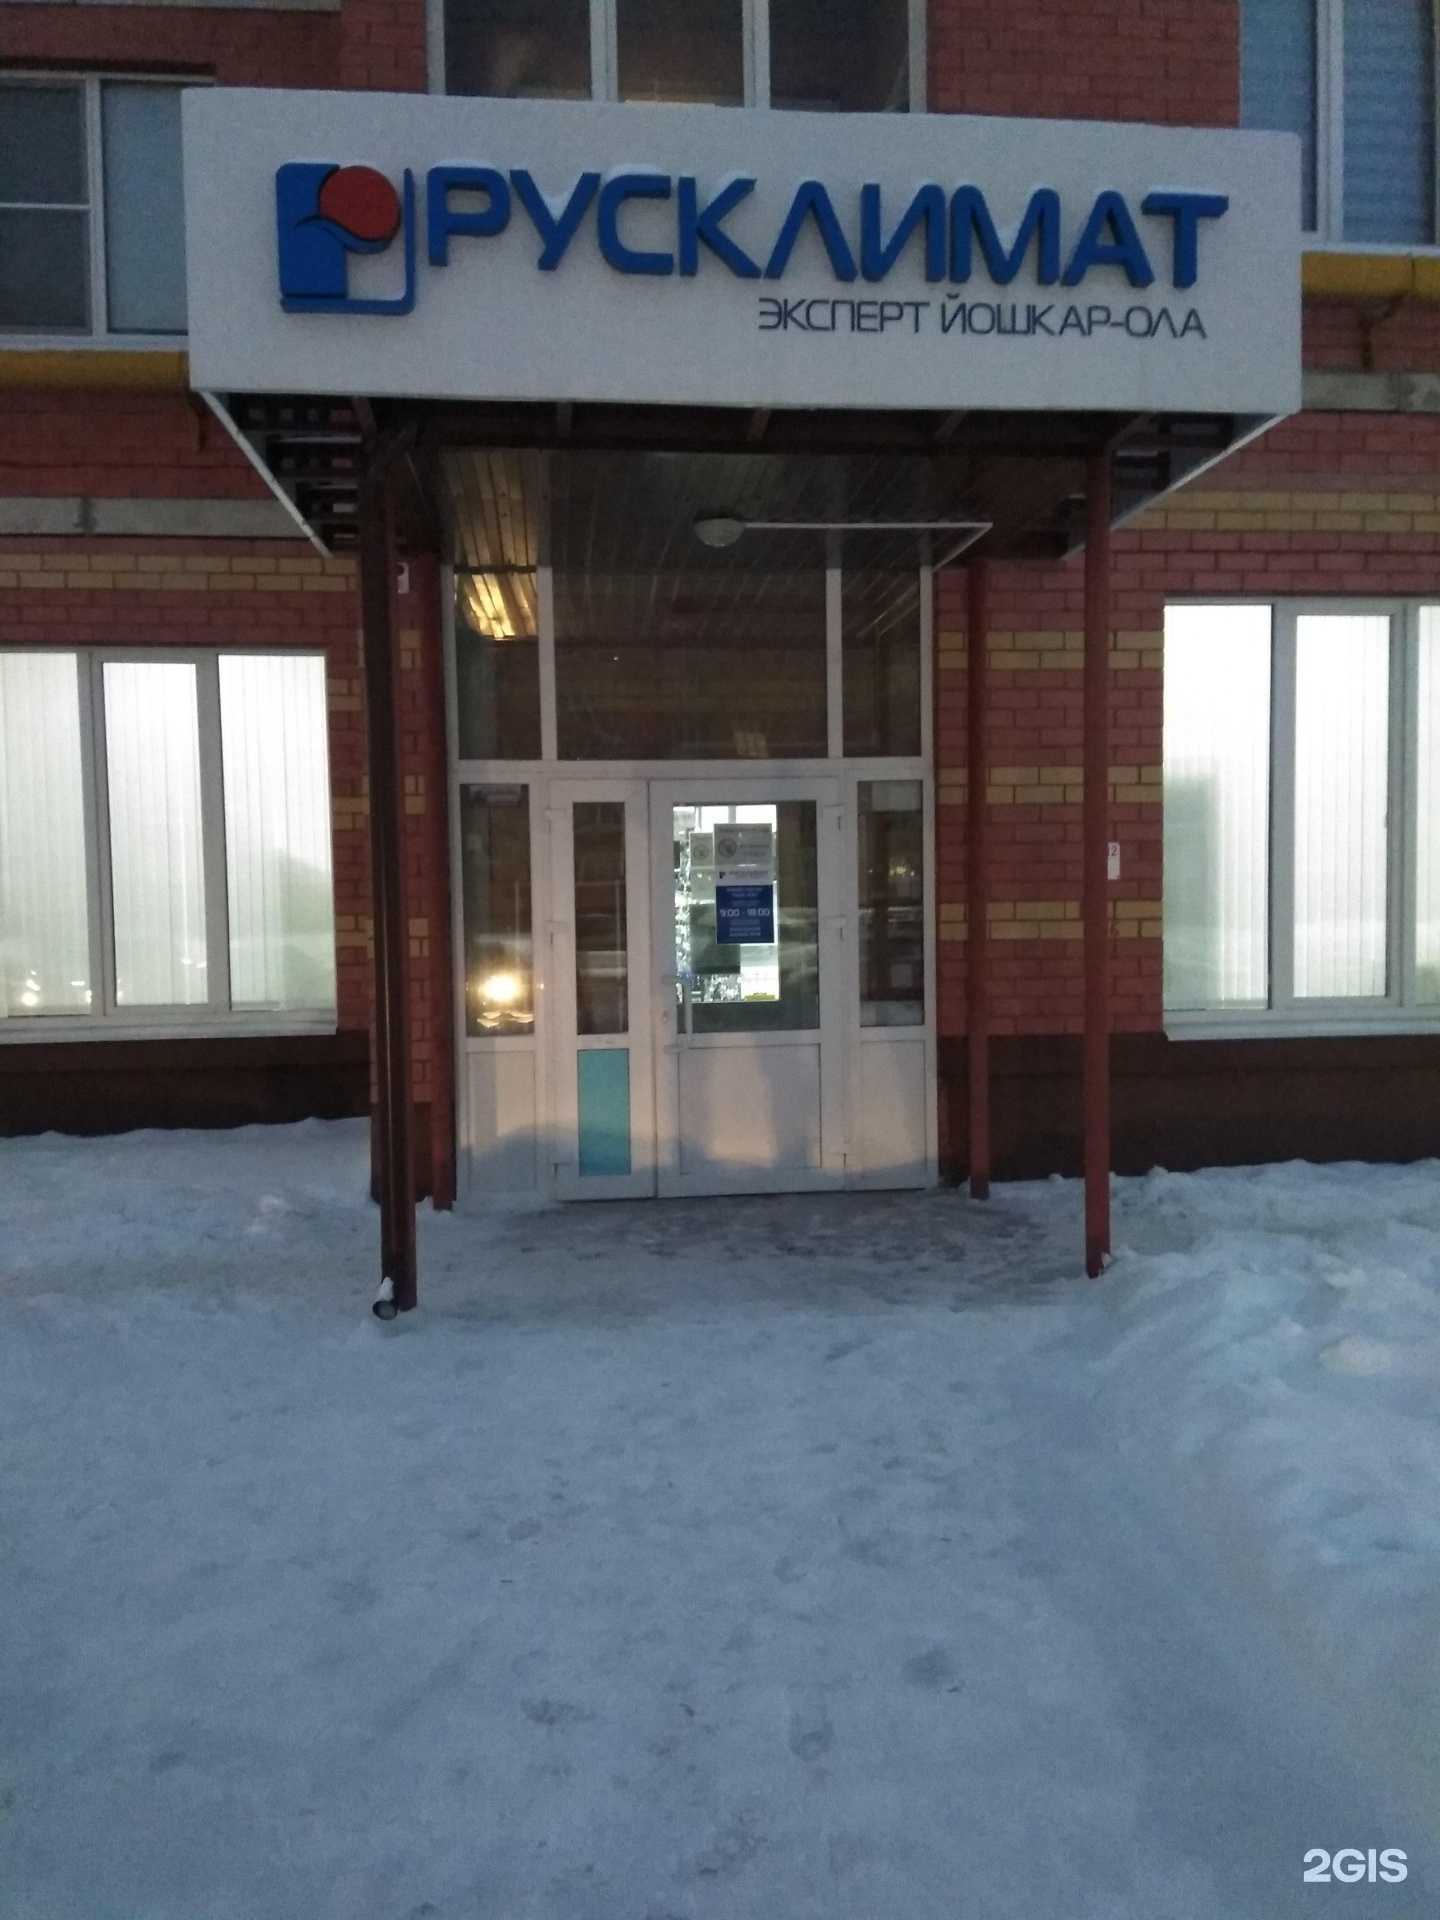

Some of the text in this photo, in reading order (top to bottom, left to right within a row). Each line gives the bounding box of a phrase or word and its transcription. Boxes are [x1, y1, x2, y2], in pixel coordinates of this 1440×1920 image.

[427, 166, 1229, 289] РУСКЛИМАТ
[758, 293, 1208, 339] ЭКСПЕРТ ЙОШКАР-ОЛА
